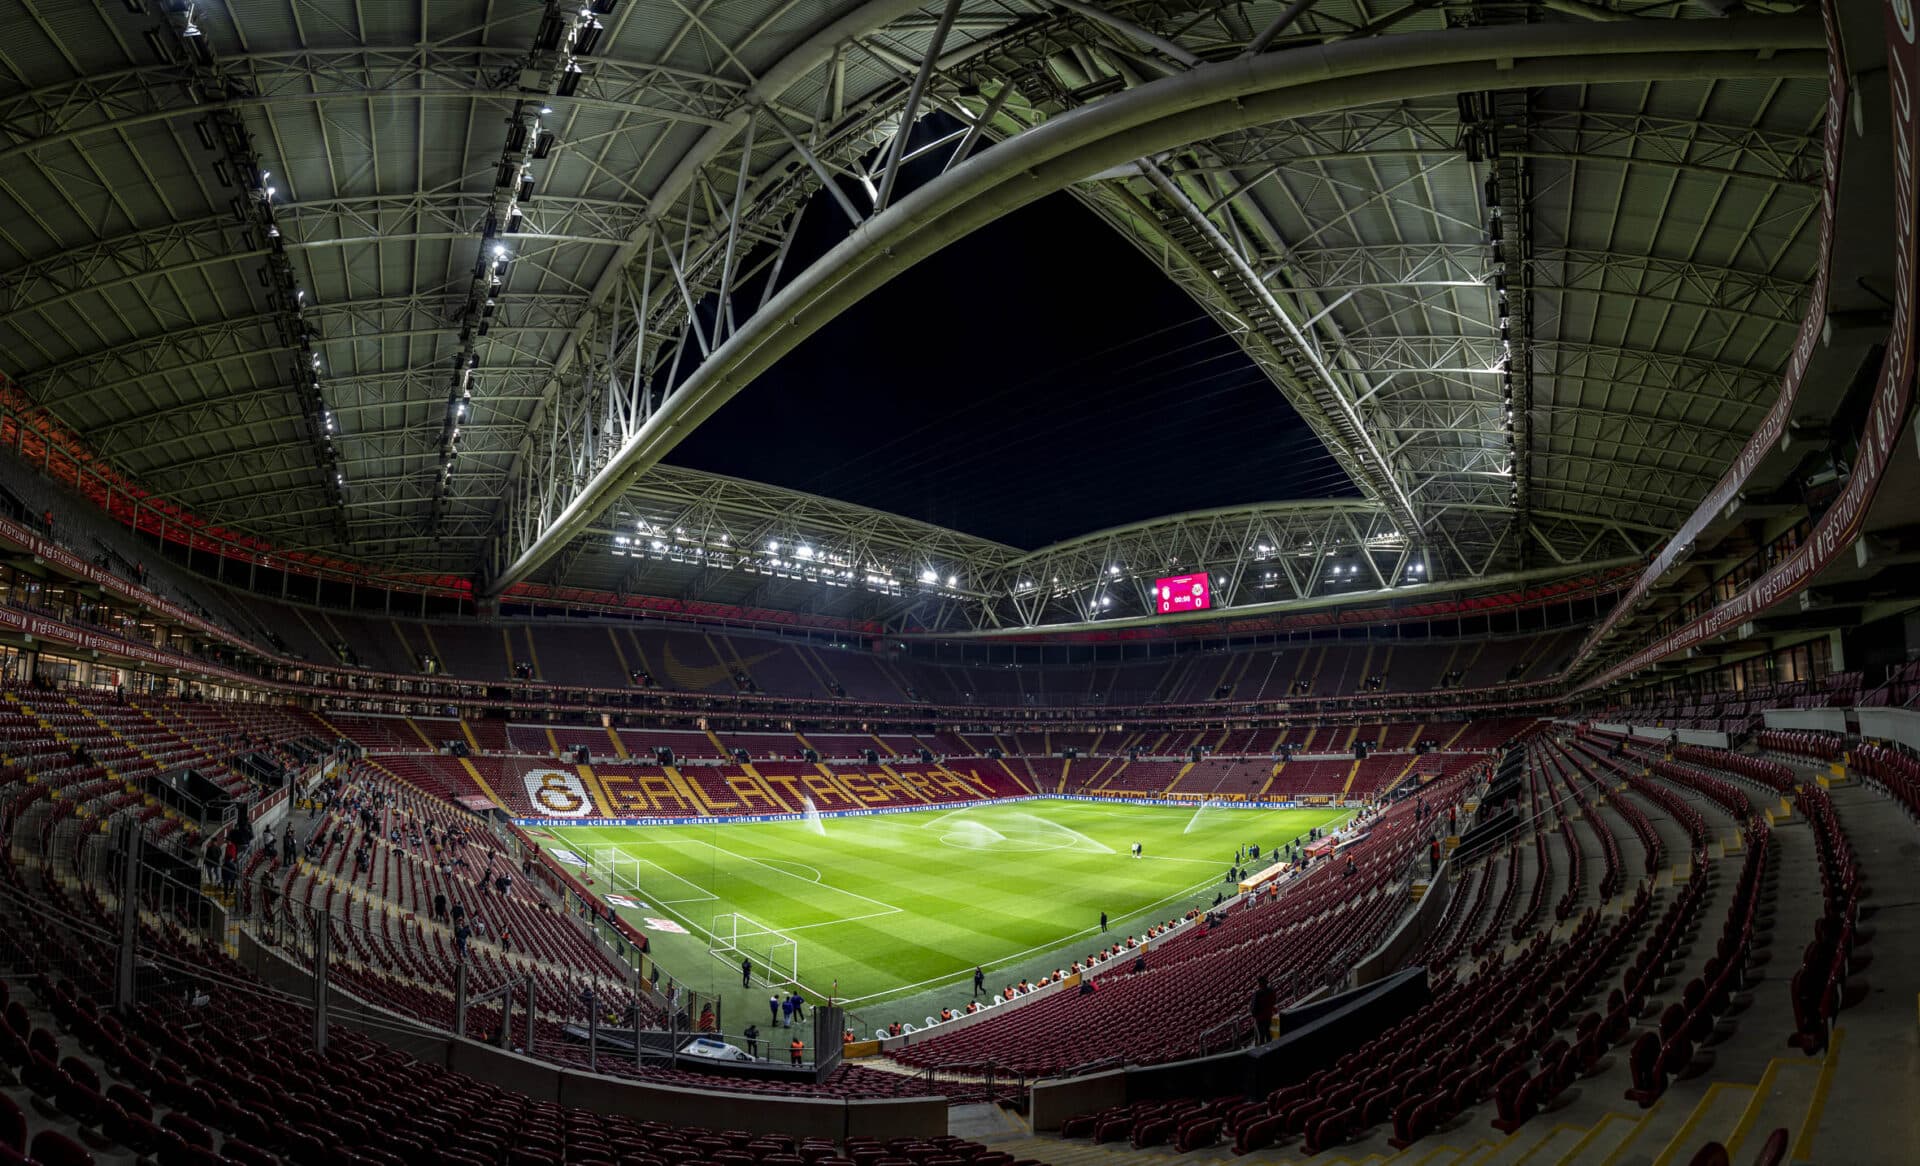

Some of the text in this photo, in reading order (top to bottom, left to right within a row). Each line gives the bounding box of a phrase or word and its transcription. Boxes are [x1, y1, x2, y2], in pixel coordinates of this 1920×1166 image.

[1834, 452, 1869, 536] STADYUMU
[1772, 551, 1809, 593] STADYUMU
[1163, 597, 1202, 611] 0 0
[1717, 597, 1747, 624] STADYUMU
[47, 625, 78, 640] STADYUMU
[598, 769, 996, 810] GALATASARAY
